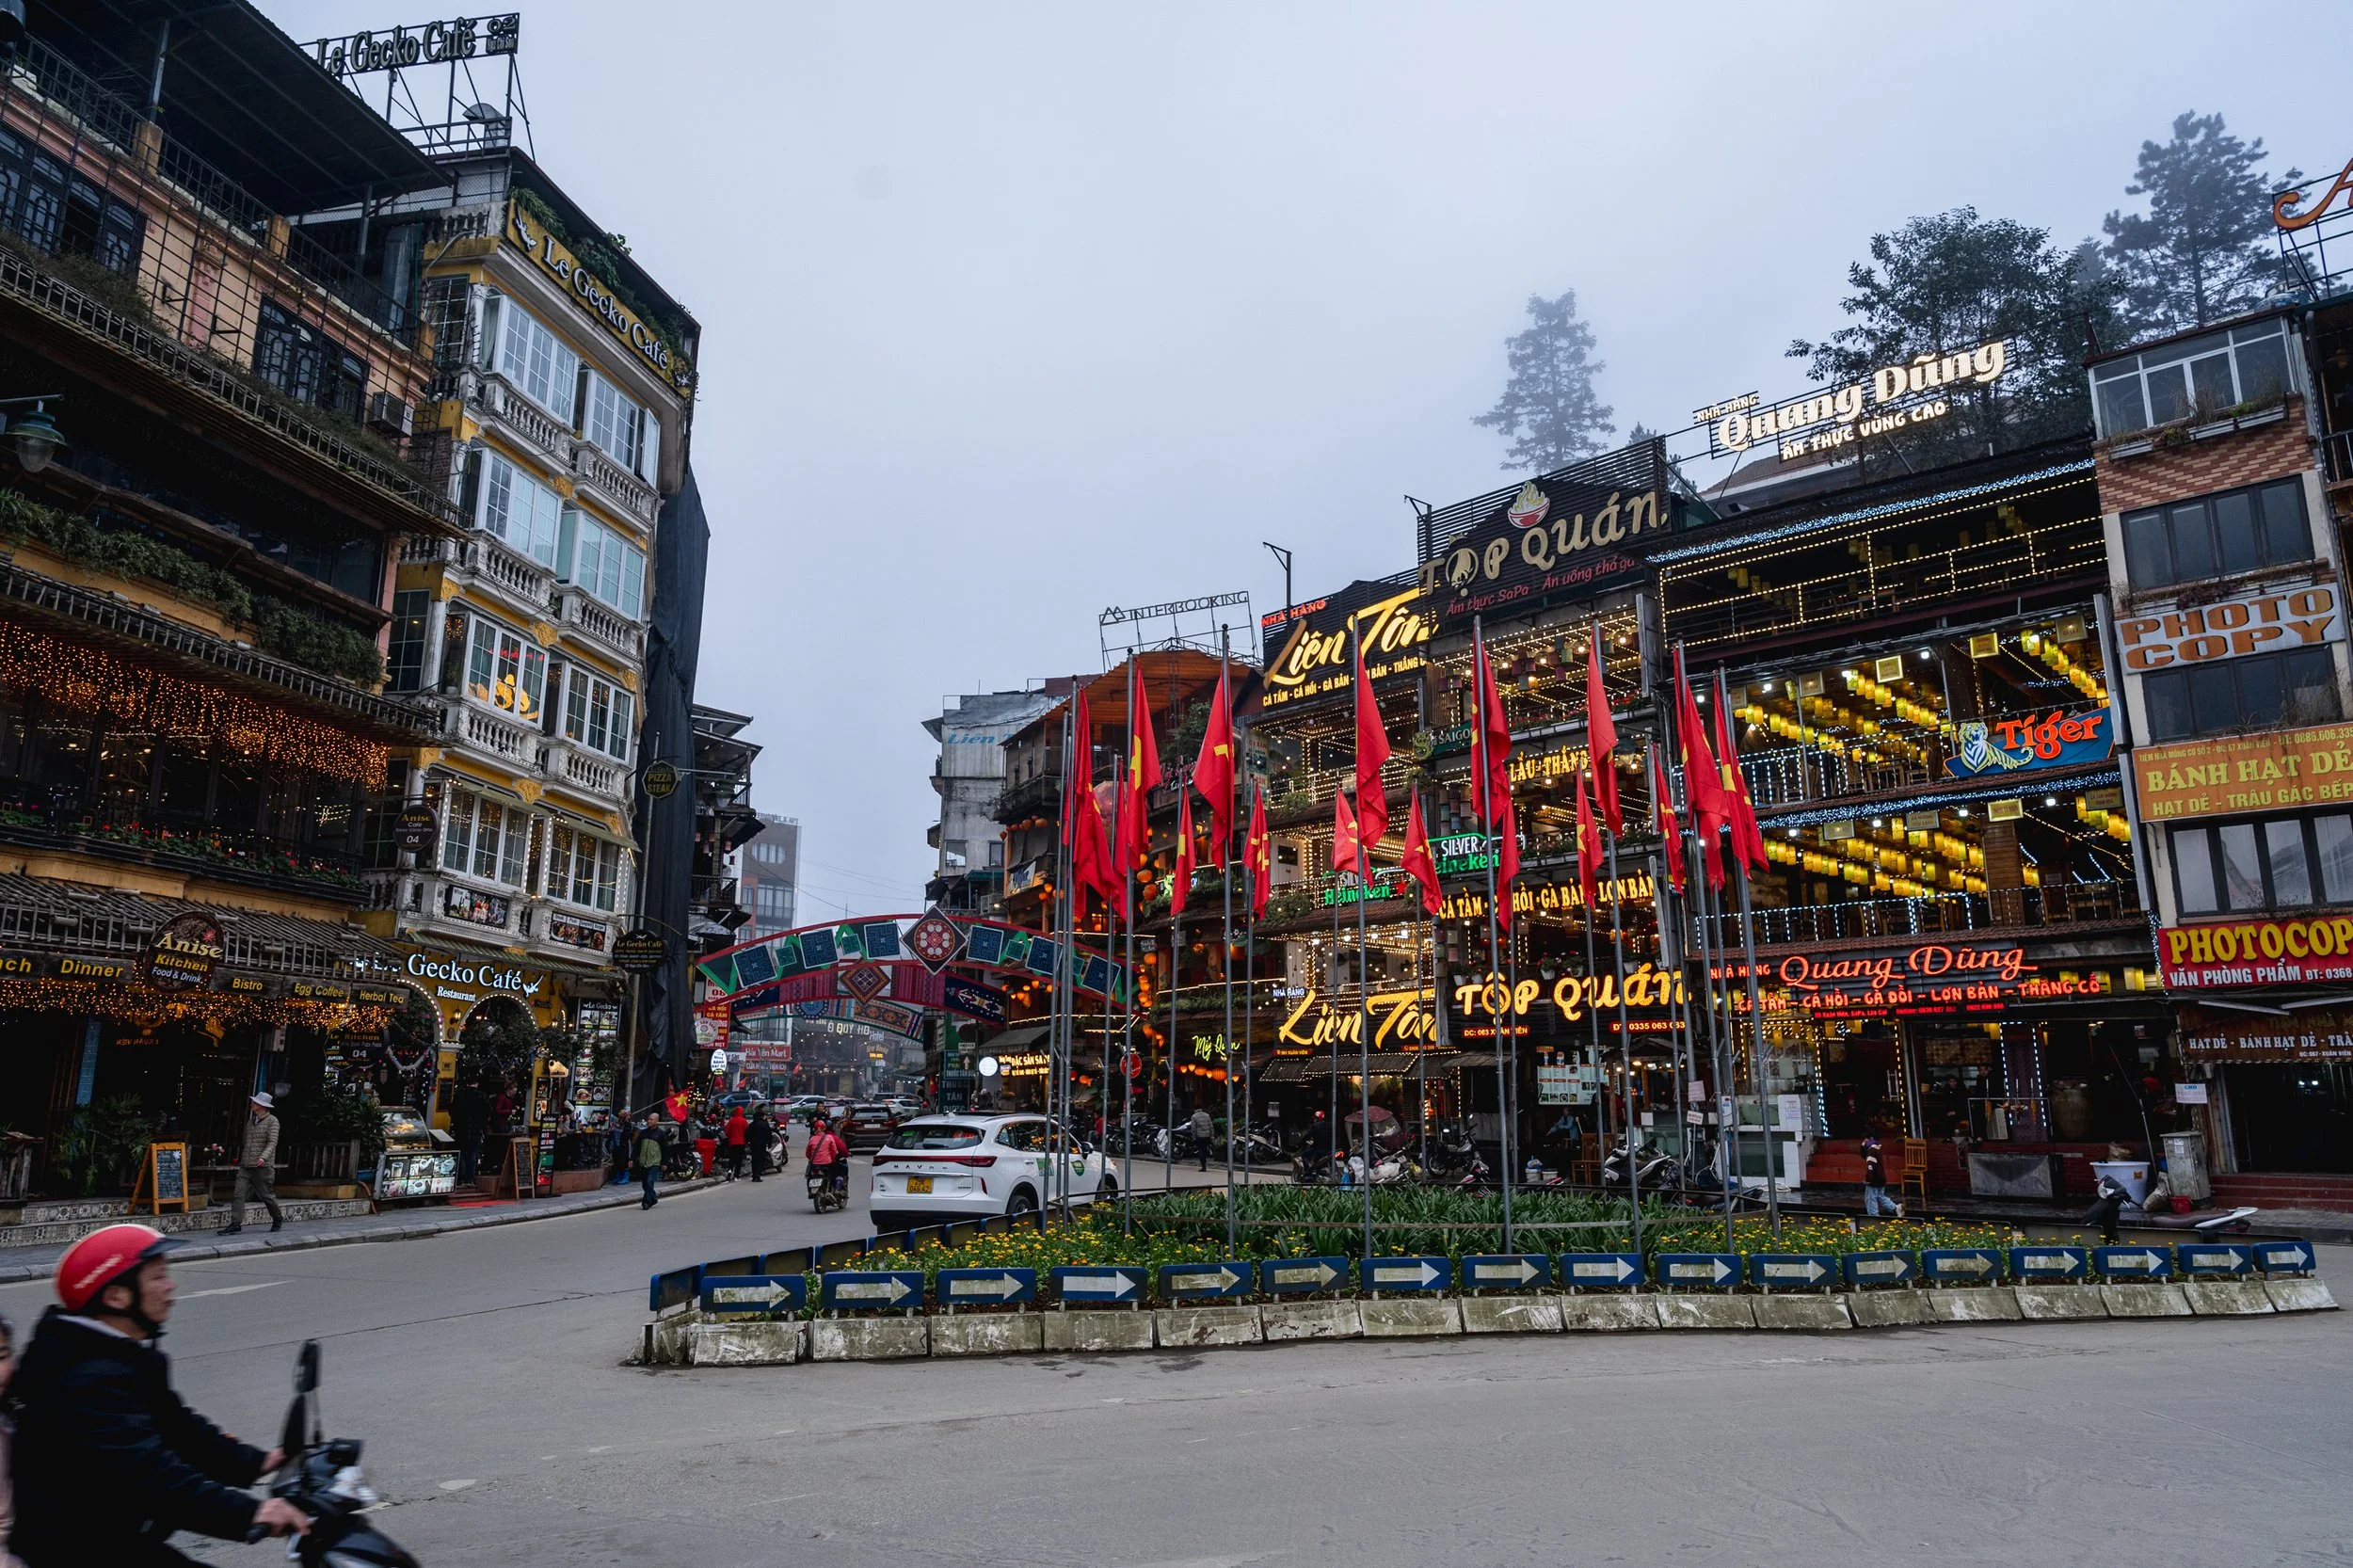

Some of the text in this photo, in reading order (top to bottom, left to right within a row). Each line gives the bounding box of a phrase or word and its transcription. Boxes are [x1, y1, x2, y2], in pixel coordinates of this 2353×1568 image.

[316, 17, 477, 74] Le Gecko Café
[542, 235, 668, 370] Le Gecko Café
[1697, 394, 1759, 422] NHÀ HÀNG
[1718, 341, 2006, 452] Quang Dũng
[1860, 411, 1906, 438] VÙNG
[1912, 400, 1946, 423] CAO
[1130, 591, 1247, 620] INTERBOOKING
[1497, 584, 1529, 602] SaPa
[1261, 600, 1327, 628] NHÀ HÀNG
[2120, 588, 2334, 646] PHOTO
[1263, 618, 1346, 690] Liên
[2125, 615, 2337, 669] COPY
[1439, 728, 1472, 744] SAIGO
[1996, 711, 2103, 759] Tiger
[647, 773, 672, 782] PIZZA
[2146, 741, 2353, 792] BÁNH HẠT DẺ
[647, 783, 672, 793] STEAK
[2153, 778, 2353, 818] HẠT DẺ TRÂU GÁC BẾP
[407, 835, 420, 844] 04
[1441, 836, 1478, 856] SILVER
[1434, 854, 1500, 875] eineken
[1324, 882, 1390, 904] Heinken
[1541, 882, 1559, 909] GÀ
[155, 932, 224, 959] Anise
[627, 939, 647, 948] Gecko
[2167, 918, 2353, 965] PHOTOCOP
[60, 959, 123, 978] Dinner
[152, 966, 202, 984] Food & Drink
[154, 954, 209, 972] Kitchen
[407, 953, 474, 984] Gecko
[478, 965, 521, 990] Café
[1780, 946, 2038, 990] Quang Dũng
[2169, 967, 2199, 986] VĂN
[2202, 964, 2252, 985] PHÒNG
[2256, 957, 2301, 982] PHẨM
[2305, 968, 2323, 980] ĐT:
[232, 978, 264, 991] Bistro
[295, 983, 344, 998] Egg Coffee
[360, 990, 405, 1004] Herbal Tea
[437, 985, 476, 1001] Restaurant
[1802, 992, 1821, 1008] CÁ
[1864, 988, 1883, 1004] GÀ
[1966, 982, 1999, 1000] BẢN
[1278, 988, 1363, 1047] Liên
[352, 1049, 367, 1058] 04
[772, 1048, 787, 1057] Mart
[1214, 1032, 1241, 1056] Qun
[2239, 1033, 2272, 1048] BÁNH
[2274, 1036, 2296, 1051] HẠT
[2328, 1031, 2353, 1047] TRÂ
